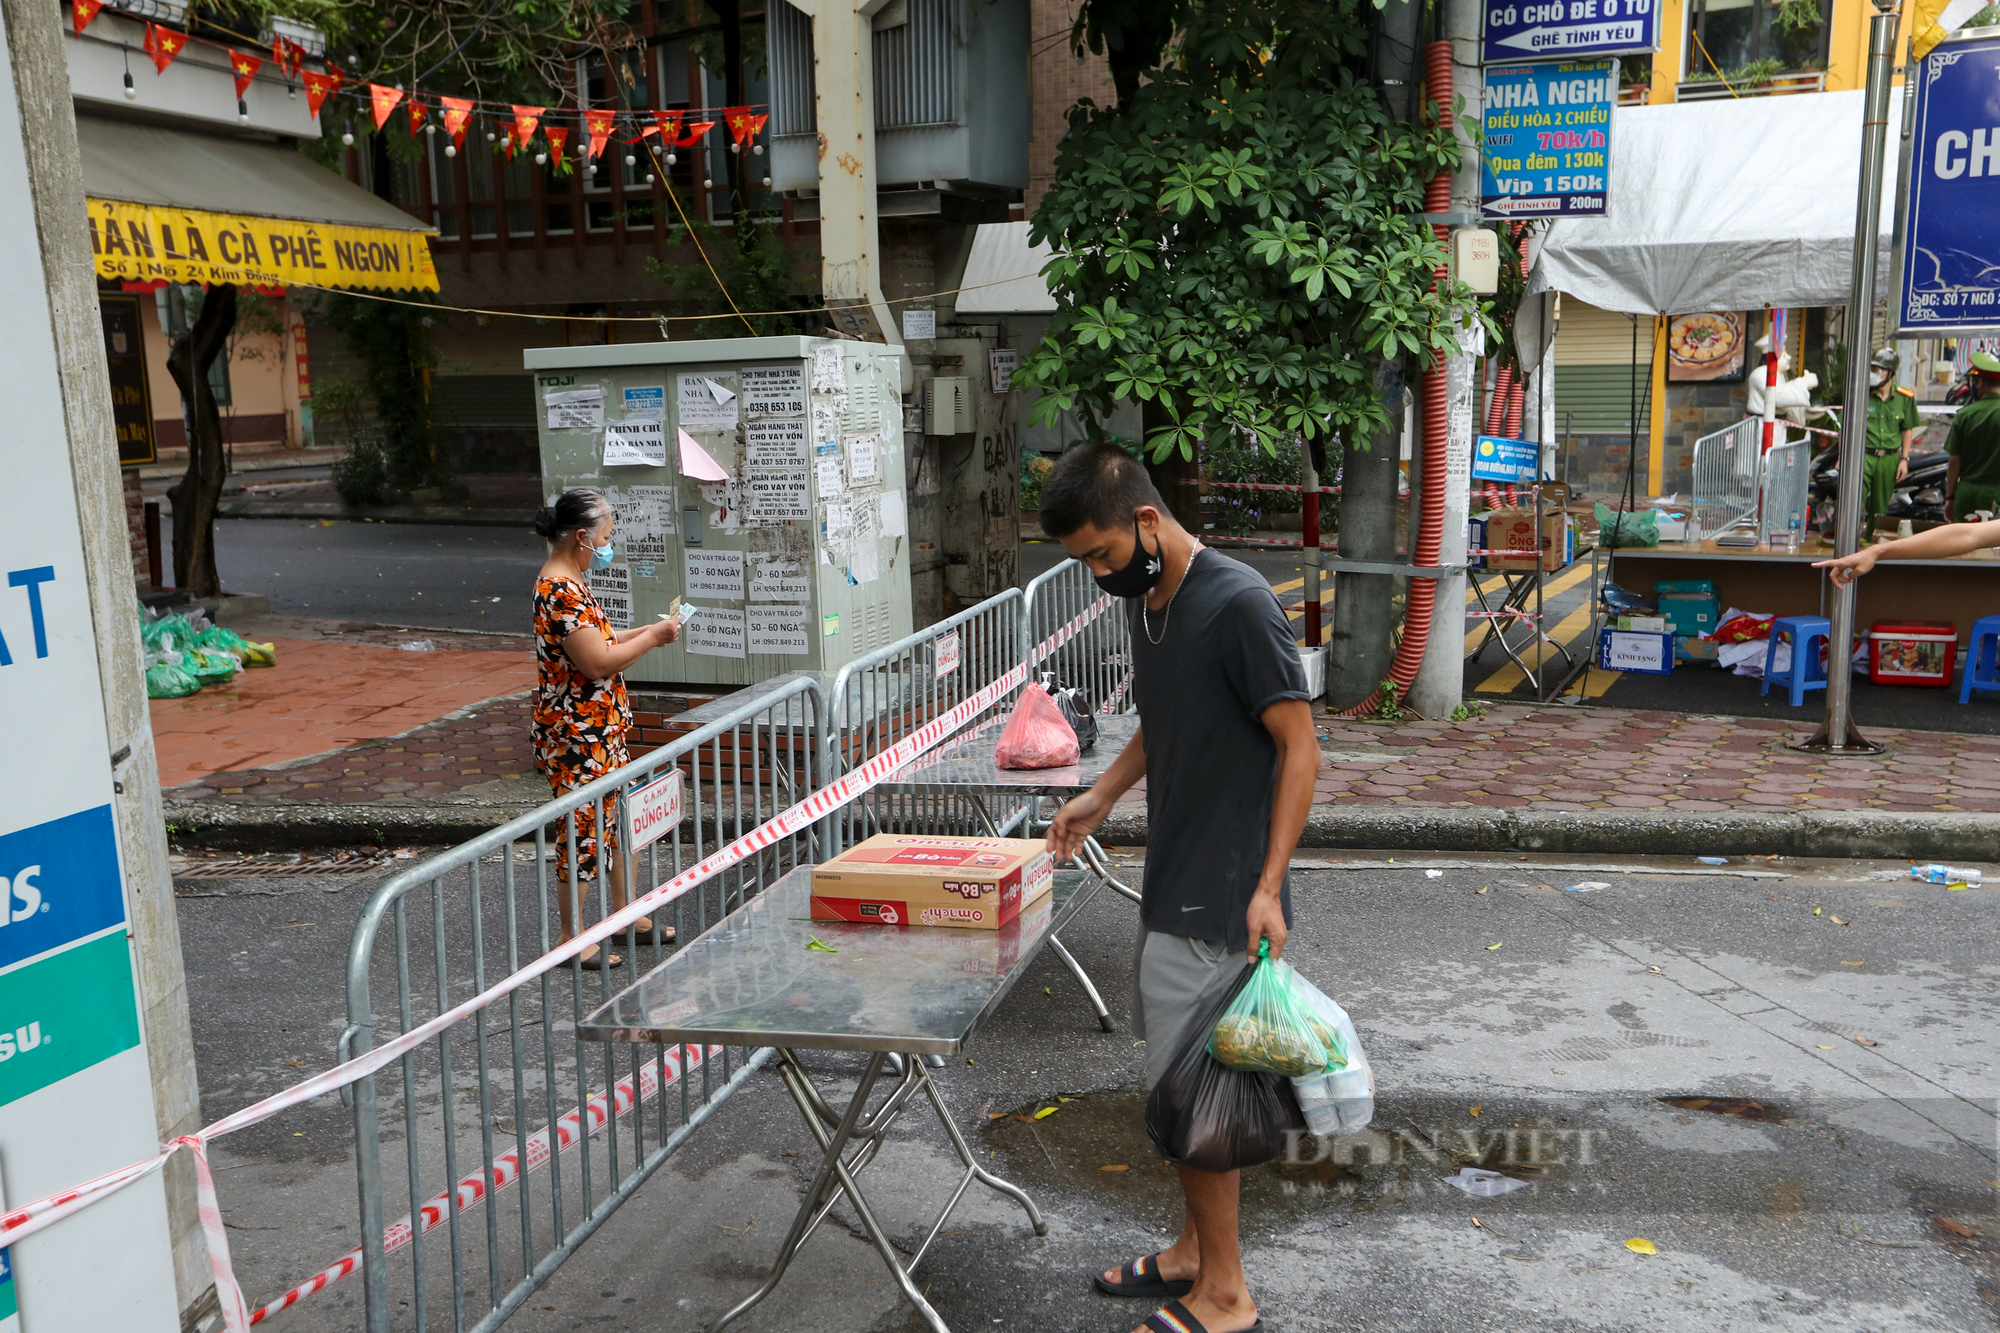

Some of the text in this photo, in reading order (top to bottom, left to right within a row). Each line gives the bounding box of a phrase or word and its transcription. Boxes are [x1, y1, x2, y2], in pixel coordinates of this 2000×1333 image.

[1490, 3, 1517, 27] CÓ
[1565, 26, 1635, 44] TÌNH YÊU
[1485, 78, 1540, 109] NHÀ
[1522, 110, 1552, 127] HÒA
[1554, 112, 1562, 126] 2
[1488, 129, 1606, 150] WIFI 70k/h
[1491, 151, 1604, 175] Qua đêm 130k
[1496, 174, 1603, 196] Vip 150k
[1517, 200, 1540, 209] TÌNH
[1541, 199, 1559, 208] YÊU
[1569, 196, 1603, 210] 200m
[161, 215, 210, 263] LÀ
[218, 222, 262, 266] CÀ
[269, 228, 327, 269] PHÊ
[334, 239, 400, 273] NGON
[136, 262, 144, 274] 1
[210, 267, 241, 280] Kim
[1961, 293, 1969, 306] 7
[769, 370, 780, 378] NHÀ
[537, 376, 575, 387] TOJI
[685, 388, 703, 398] NHÀ
[750, 402, 769, 412] 0358
[771, 402, 785, 412] 653
[608, 421, 662, 433] CHÍNH CHỦ
[749, 423, 767, 431] NGÂN
[768, 422, 785, 430] HÀNG
[786, 430, 803, 440] VỐN
[628, 439, 644, 447] BÁN
[646, 438, 663, 447] NHÀ
[789, 481, 805, 490] VỐN
[1508, 534, 1535, 546] ÔNG
[727, 554, 740, 562] GÓP
[689, 566, 741, 578] 50 60 NGÀY
[769, 570, 780, 579] 60
[716, 612, 727, 620] TRẢ
[728, 613, 742, 621] GÓP
[777, 609, 788, 617] TRẢ
[790, 609, 803, 617] GÓP
[691, 623, 742, 636] 50 60 NGÀY
[751, 623, 762, 632] 50
[768, 623, 778, 632] 60
[633, 794, 678, 835] DỪNG LẠI
[895, 838, 999, 848] Omachi
[913, 853, 940, 861] Bò
[1027, 857, 1054, 889] Omachi
[960, 882, 981, 899] Bò
[927, 907, 984, 922] Omachi
